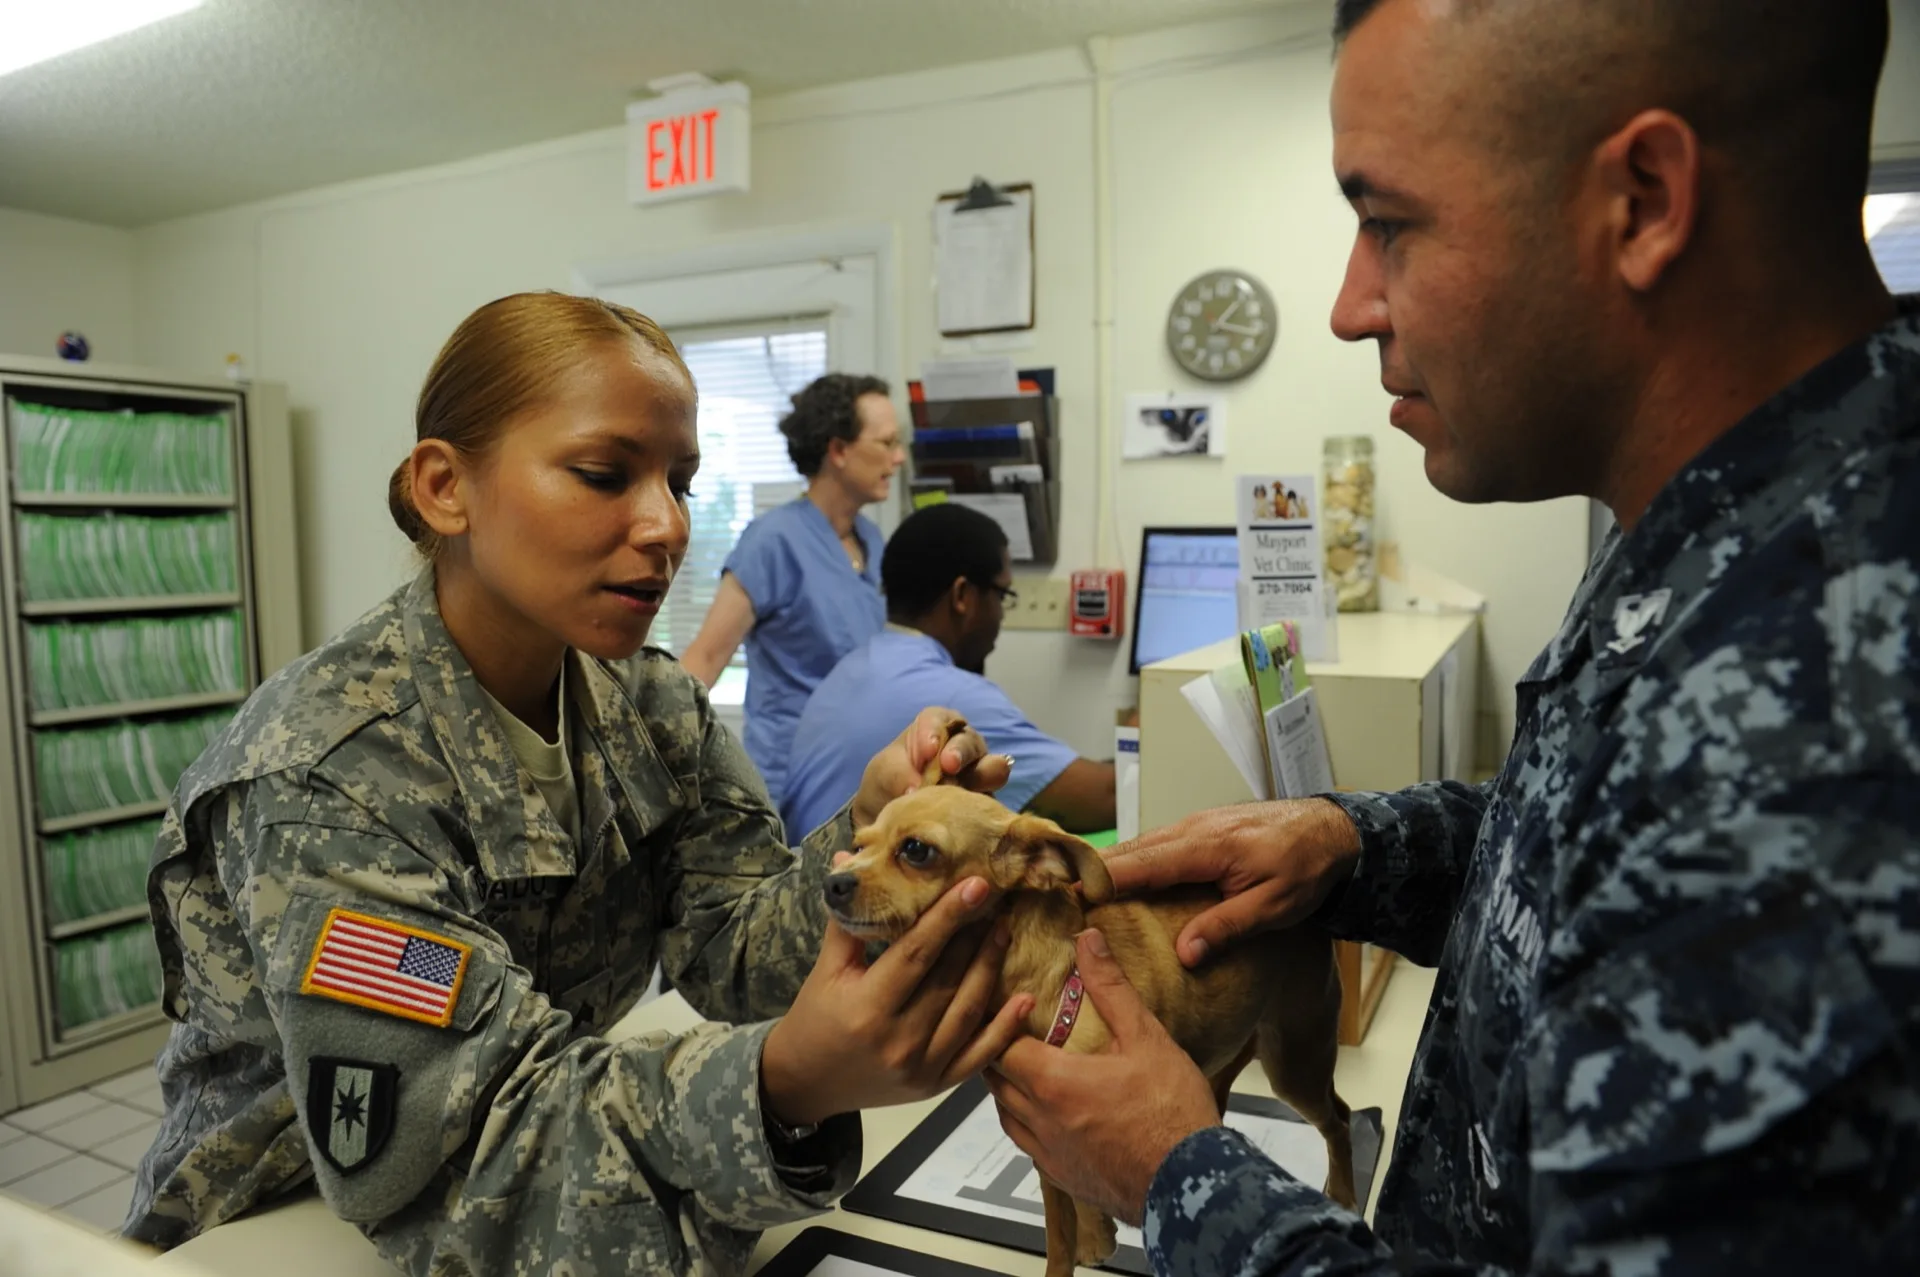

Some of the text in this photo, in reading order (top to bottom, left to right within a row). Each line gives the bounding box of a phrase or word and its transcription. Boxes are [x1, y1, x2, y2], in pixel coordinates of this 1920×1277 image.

[646, 108, 720, 192] EXIT
[1256, 533, 1307, 554] Mayport
[1254, 556, 1313, 573] Vet Clinic
